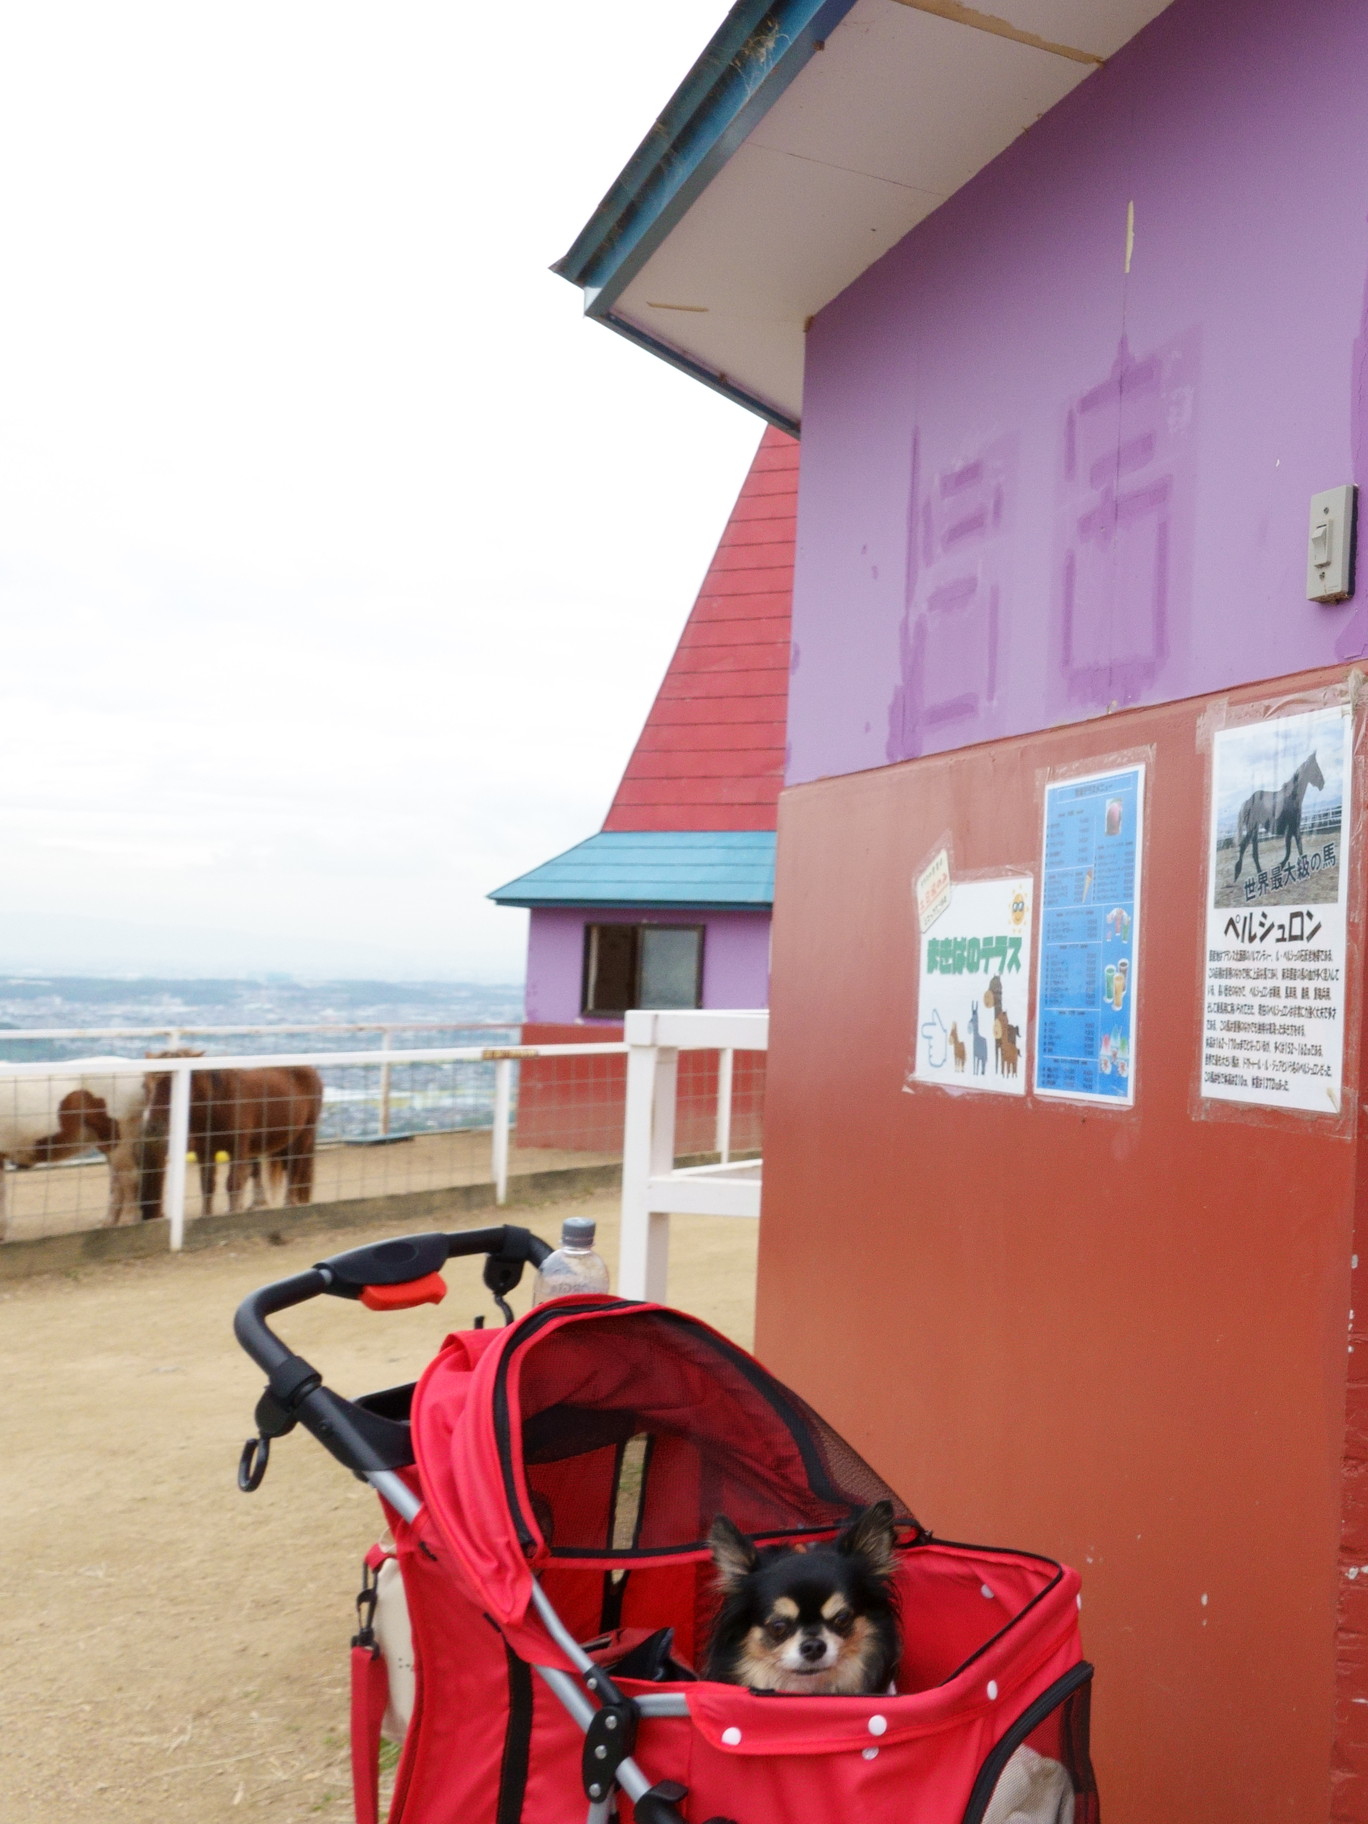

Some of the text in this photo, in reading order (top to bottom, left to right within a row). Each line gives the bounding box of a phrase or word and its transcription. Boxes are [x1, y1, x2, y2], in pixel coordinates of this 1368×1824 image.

[1244, 842, 1336, 901] 世界最大級の馬
[1224, 909, 1322, 944] ペルシュロン
